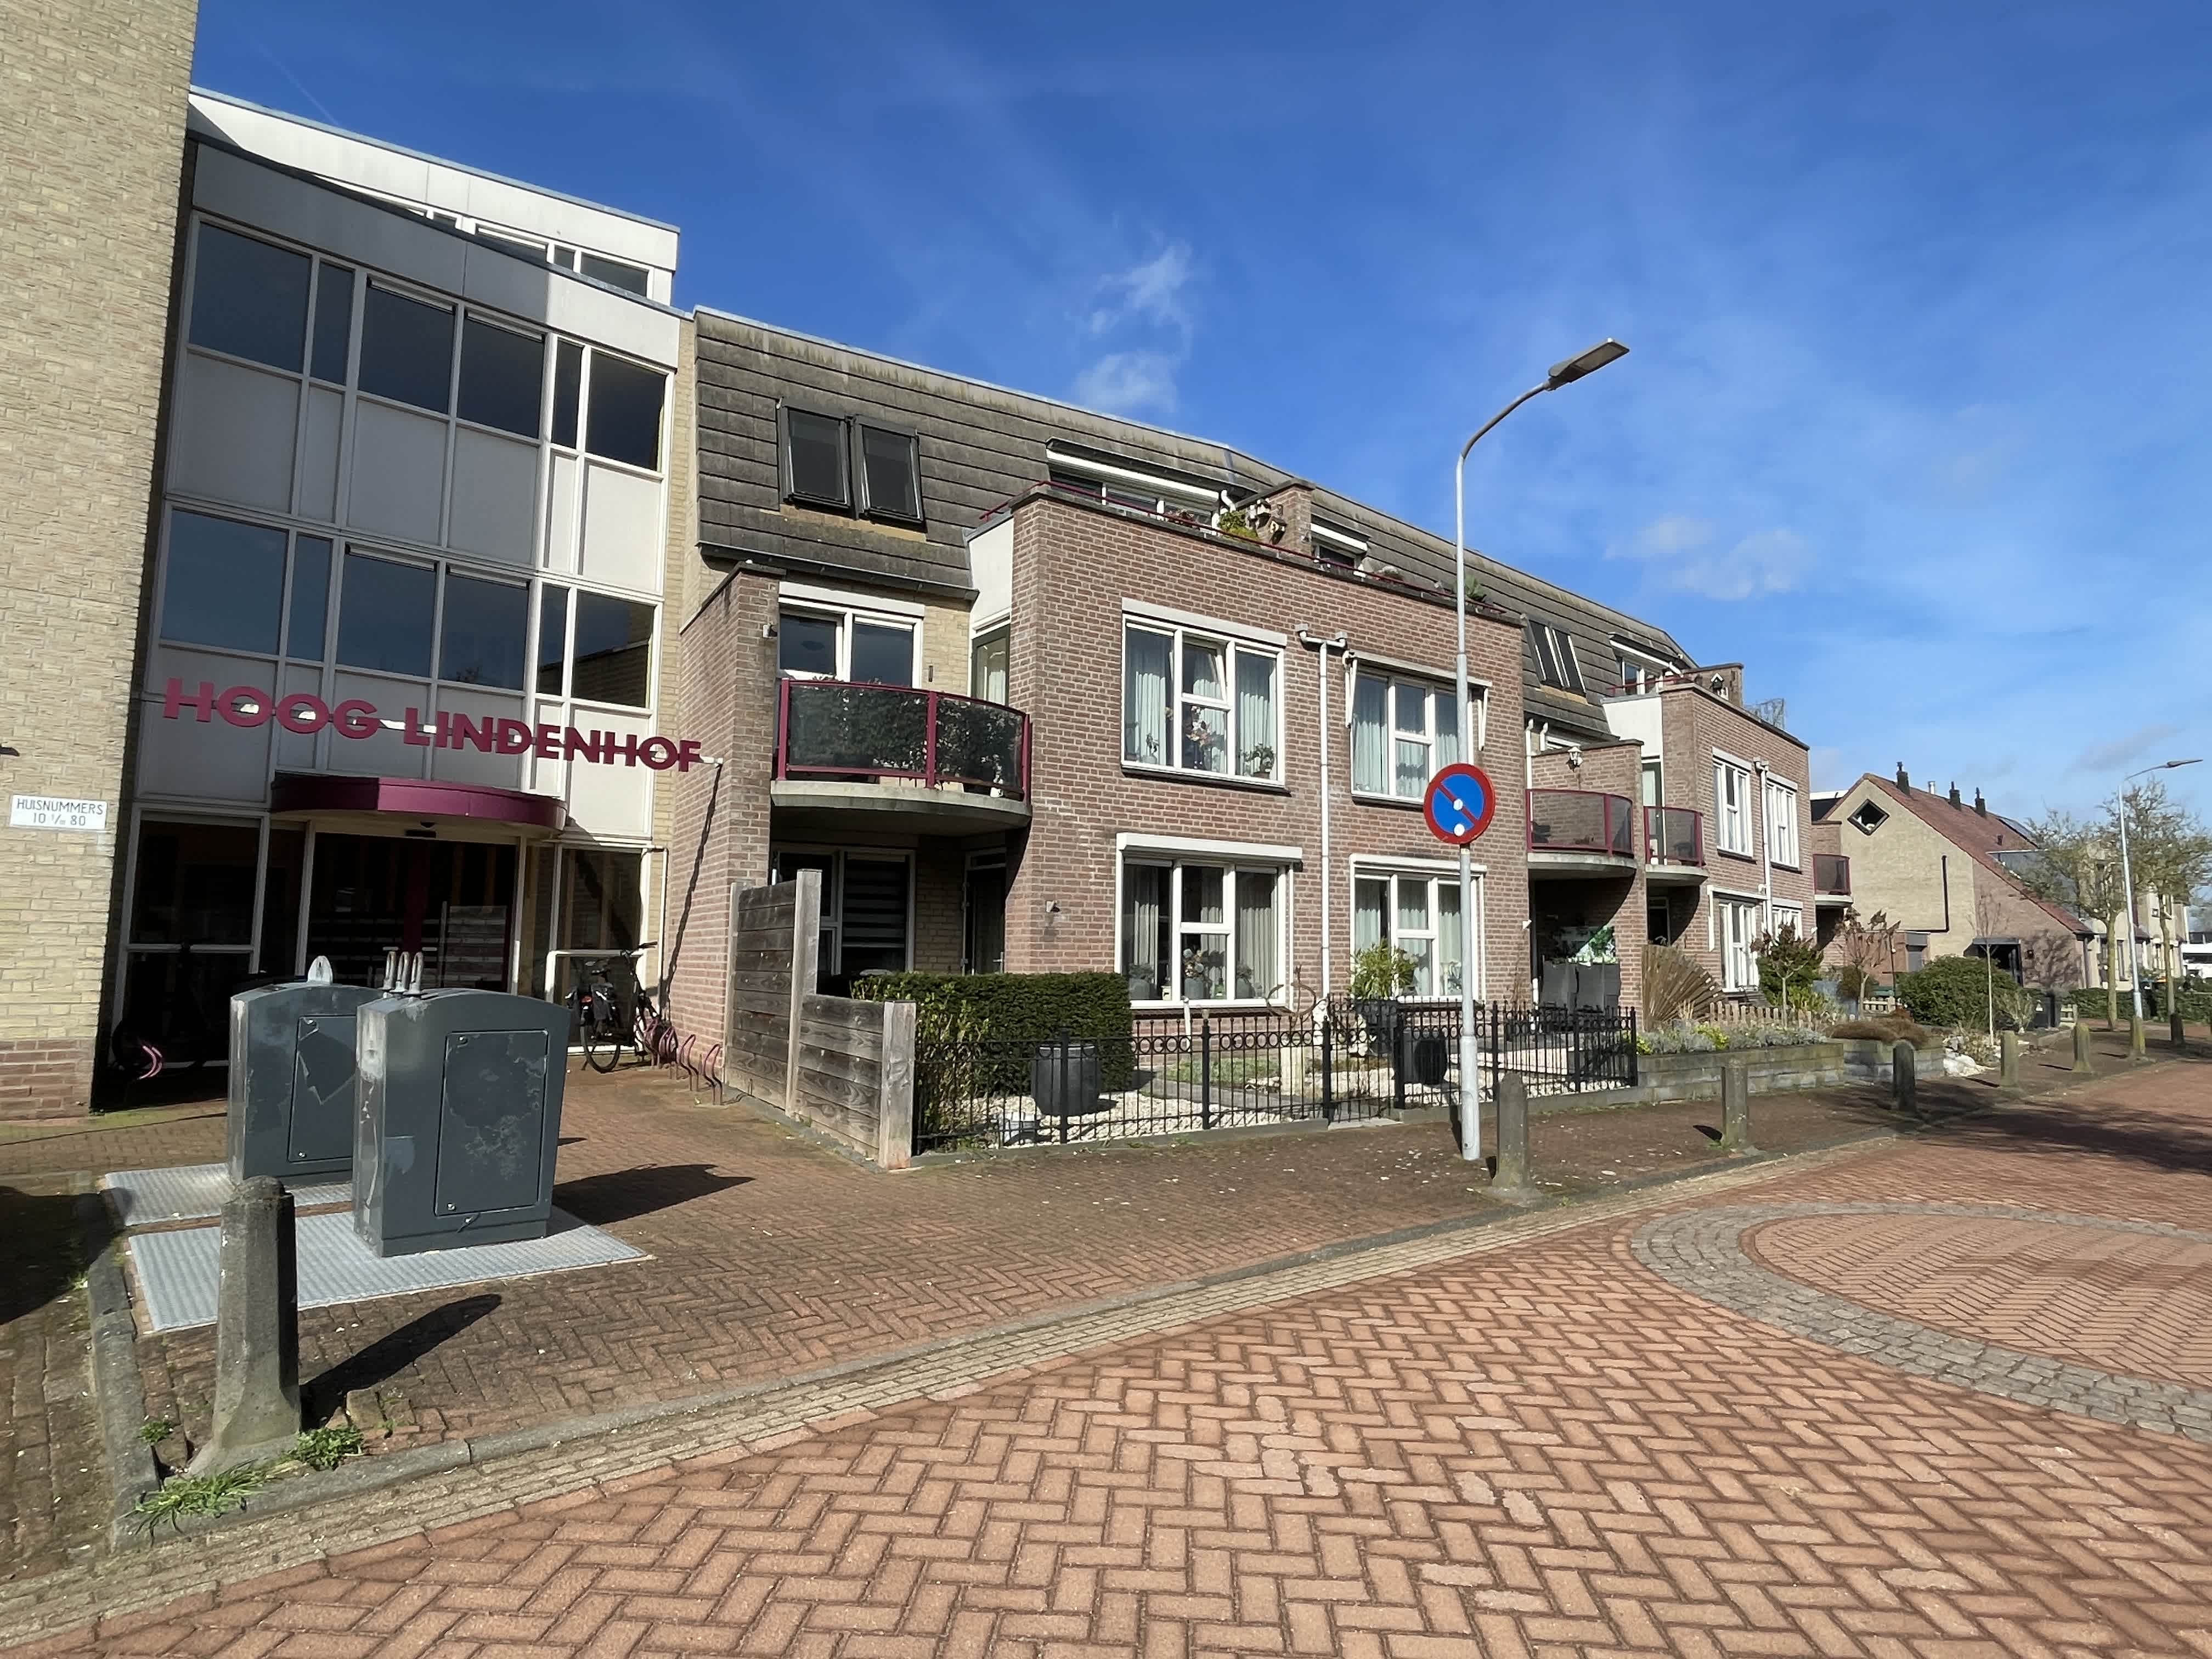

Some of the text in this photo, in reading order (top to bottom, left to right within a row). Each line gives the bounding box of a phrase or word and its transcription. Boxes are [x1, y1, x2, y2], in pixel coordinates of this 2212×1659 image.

[163, 677, 701, 772] HOOG LINDENHOF
[16, 798, 104, 815] HUISNUMMERS
[33, 812, 46, 824] 10
[70, 815, 86, 826] 80
